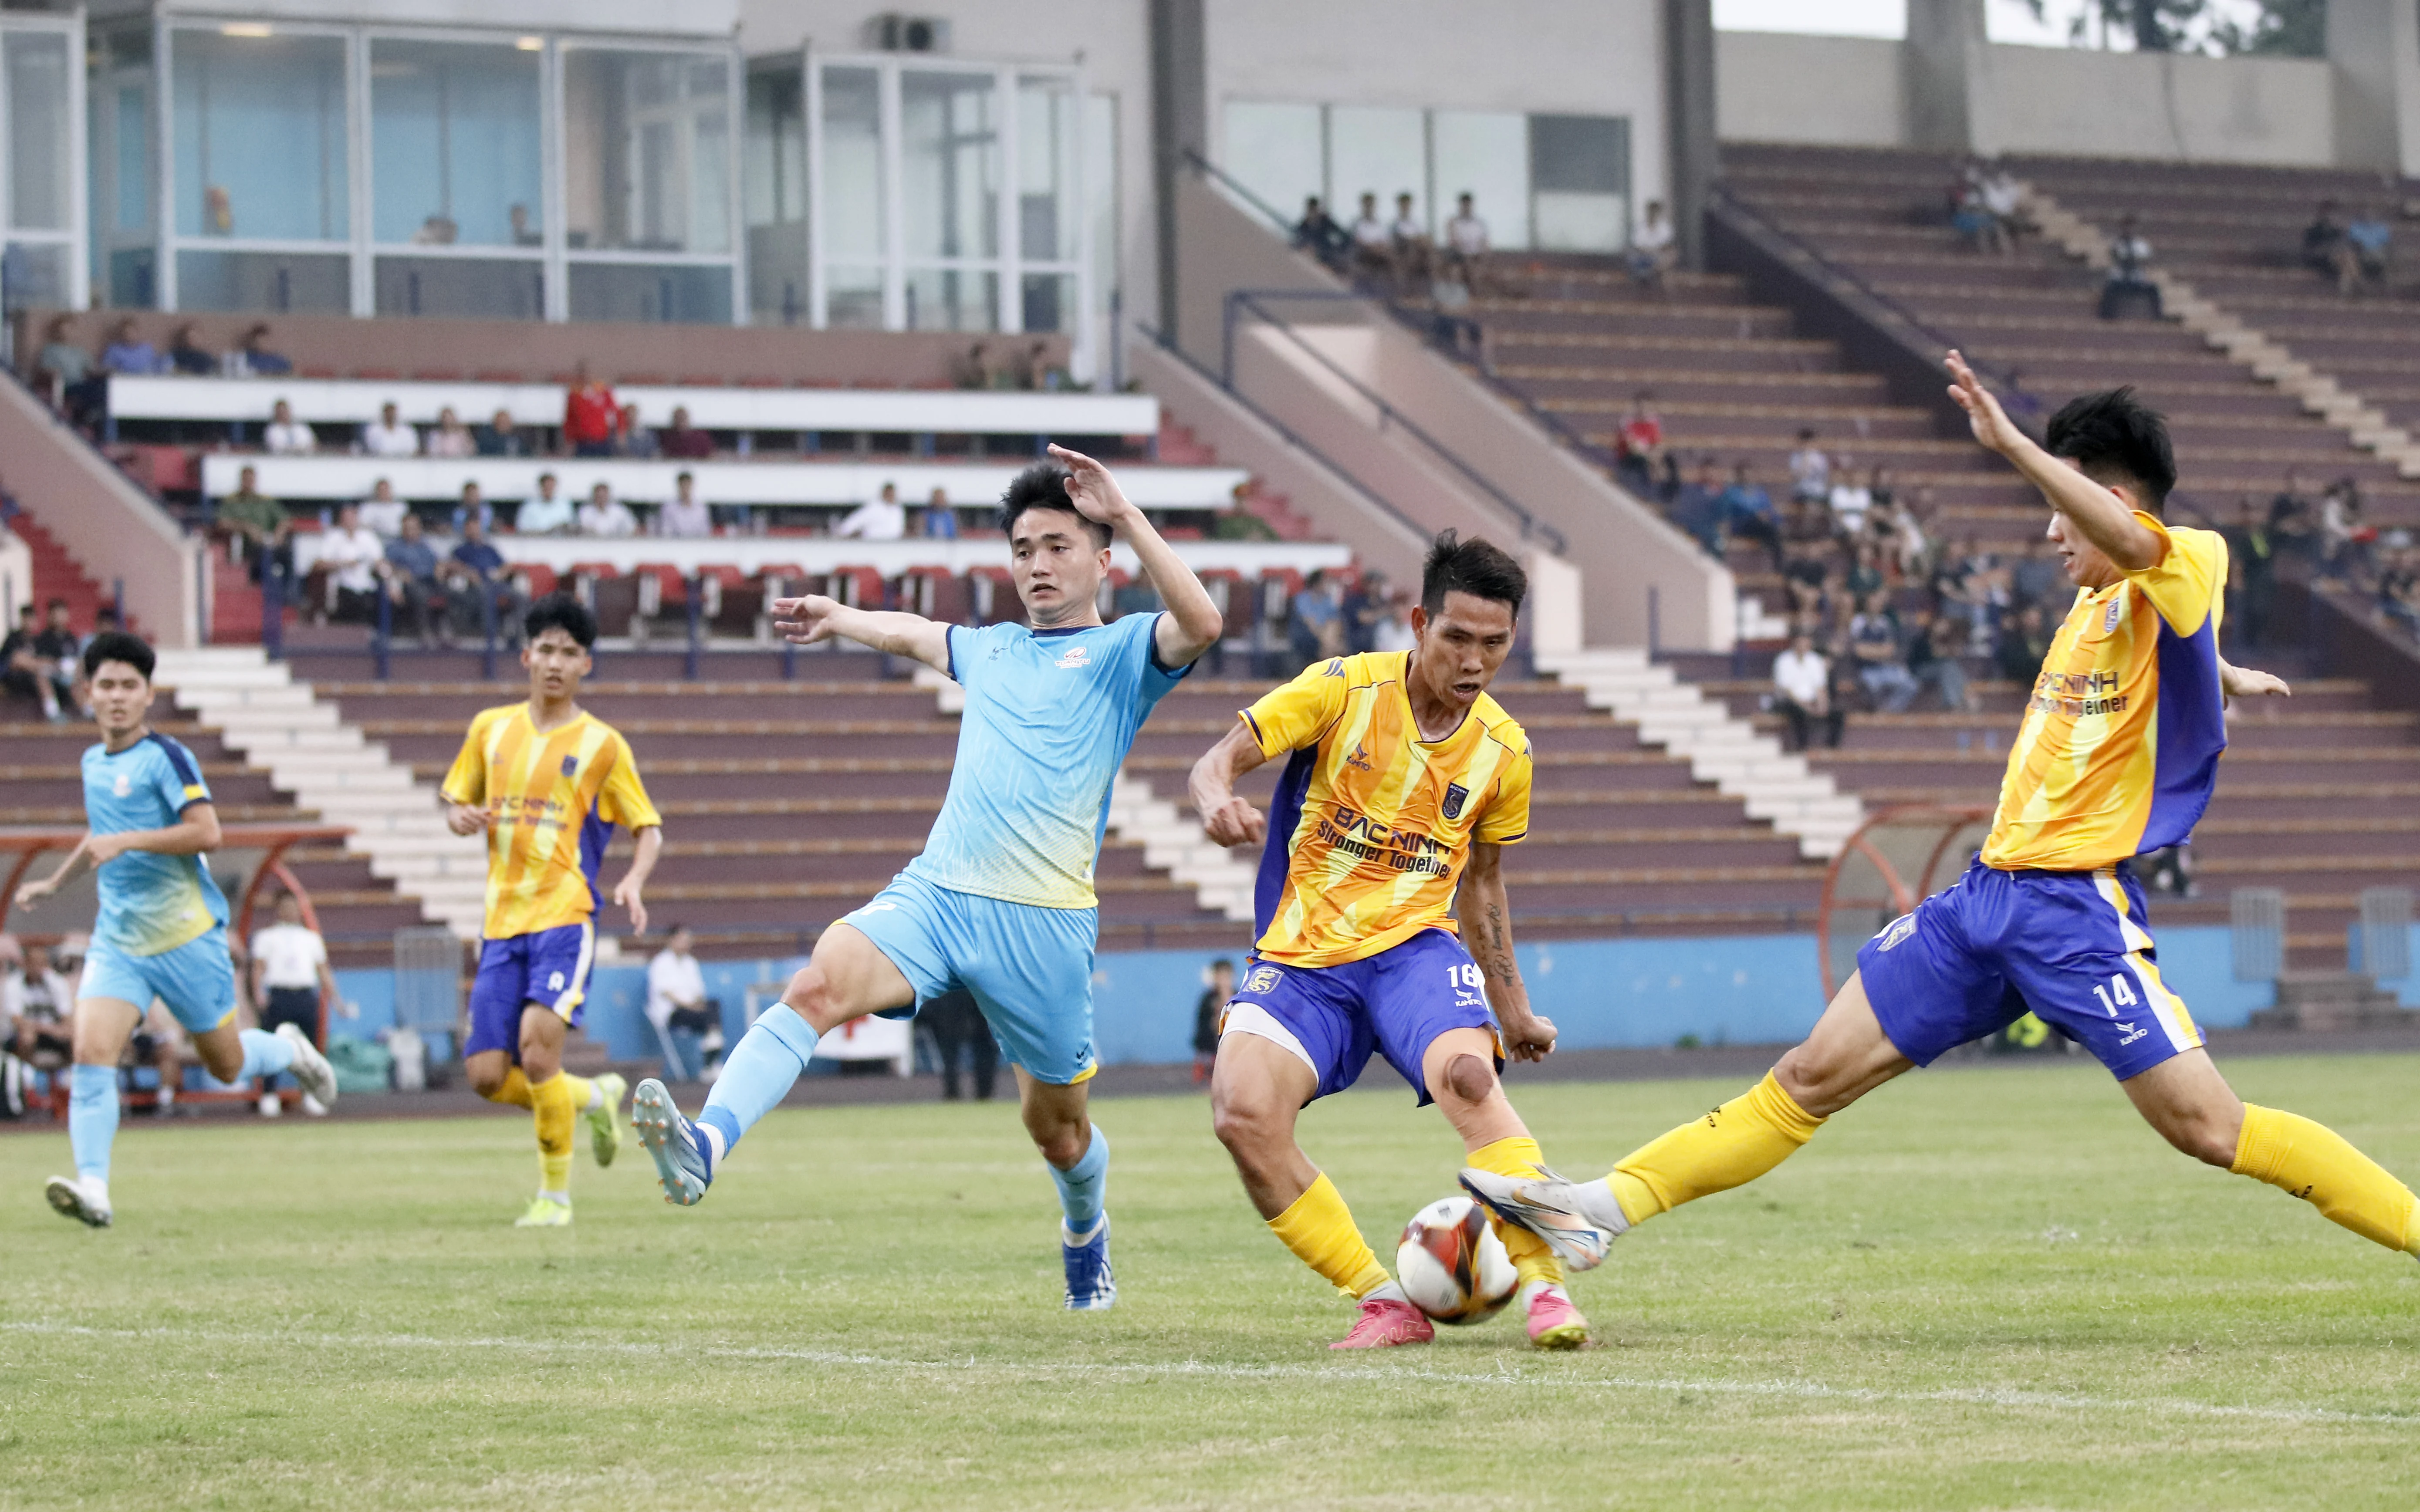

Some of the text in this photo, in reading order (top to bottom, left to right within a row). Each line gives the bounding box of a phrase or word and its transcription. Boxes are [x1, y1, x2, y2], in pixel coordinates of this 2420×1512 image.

[1317, 820, 1451, 879] Stronger Together
[1334, 805, 1452, 855] BAC NINH
[1446, 963, 1478, 988] 16
[2092, 972, 2138, 1018] 14
[1455, 999, 1482, 1007] KAMITO
